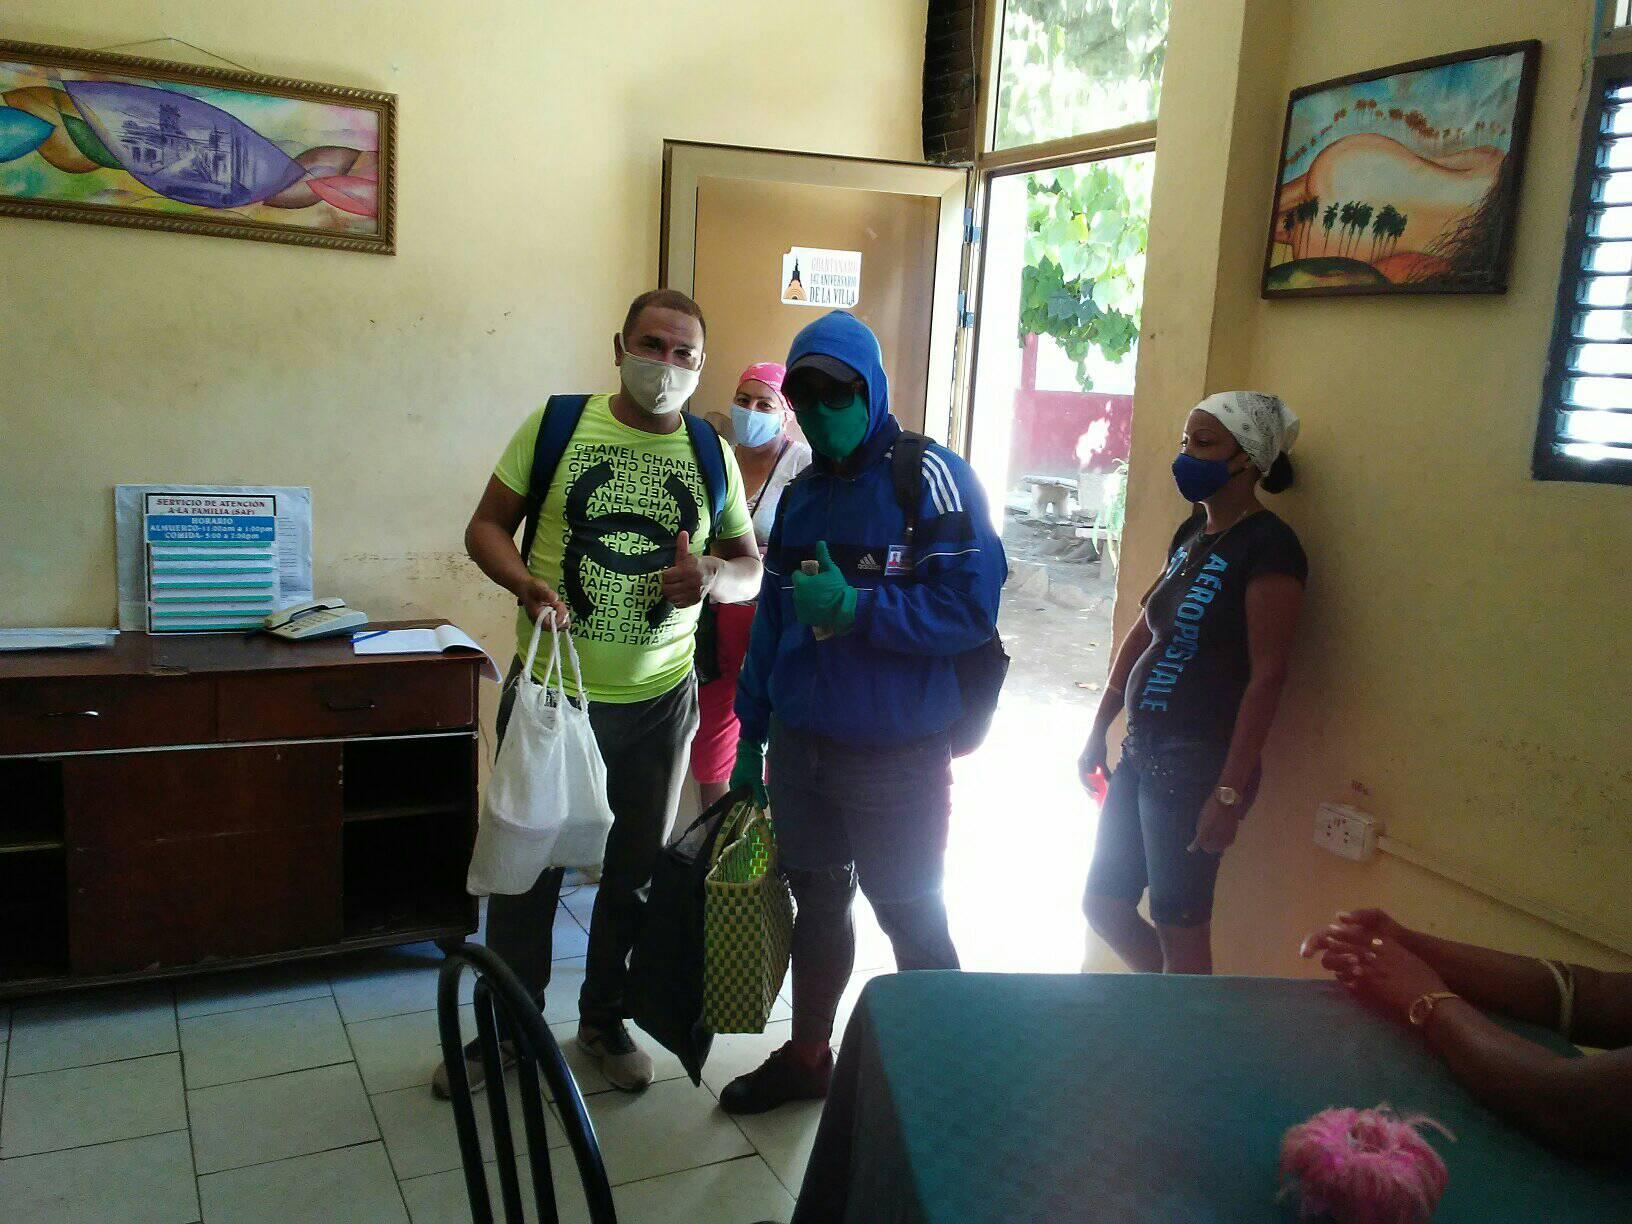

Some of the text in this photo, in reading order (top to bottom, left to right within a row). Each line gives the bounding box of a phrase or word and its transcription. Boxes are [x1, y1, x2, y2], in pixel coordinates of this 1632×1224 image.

[809, 286, 855, 305] DE LA VILLA
[574, 443, 697, 473] CHANEL CHANE
[156, 498, 265, 508] SERVICIO DE ATENCIÓN
[191, 507, 229, 515] FAMILIA
[231, 508, 255, 516] (SAF)
